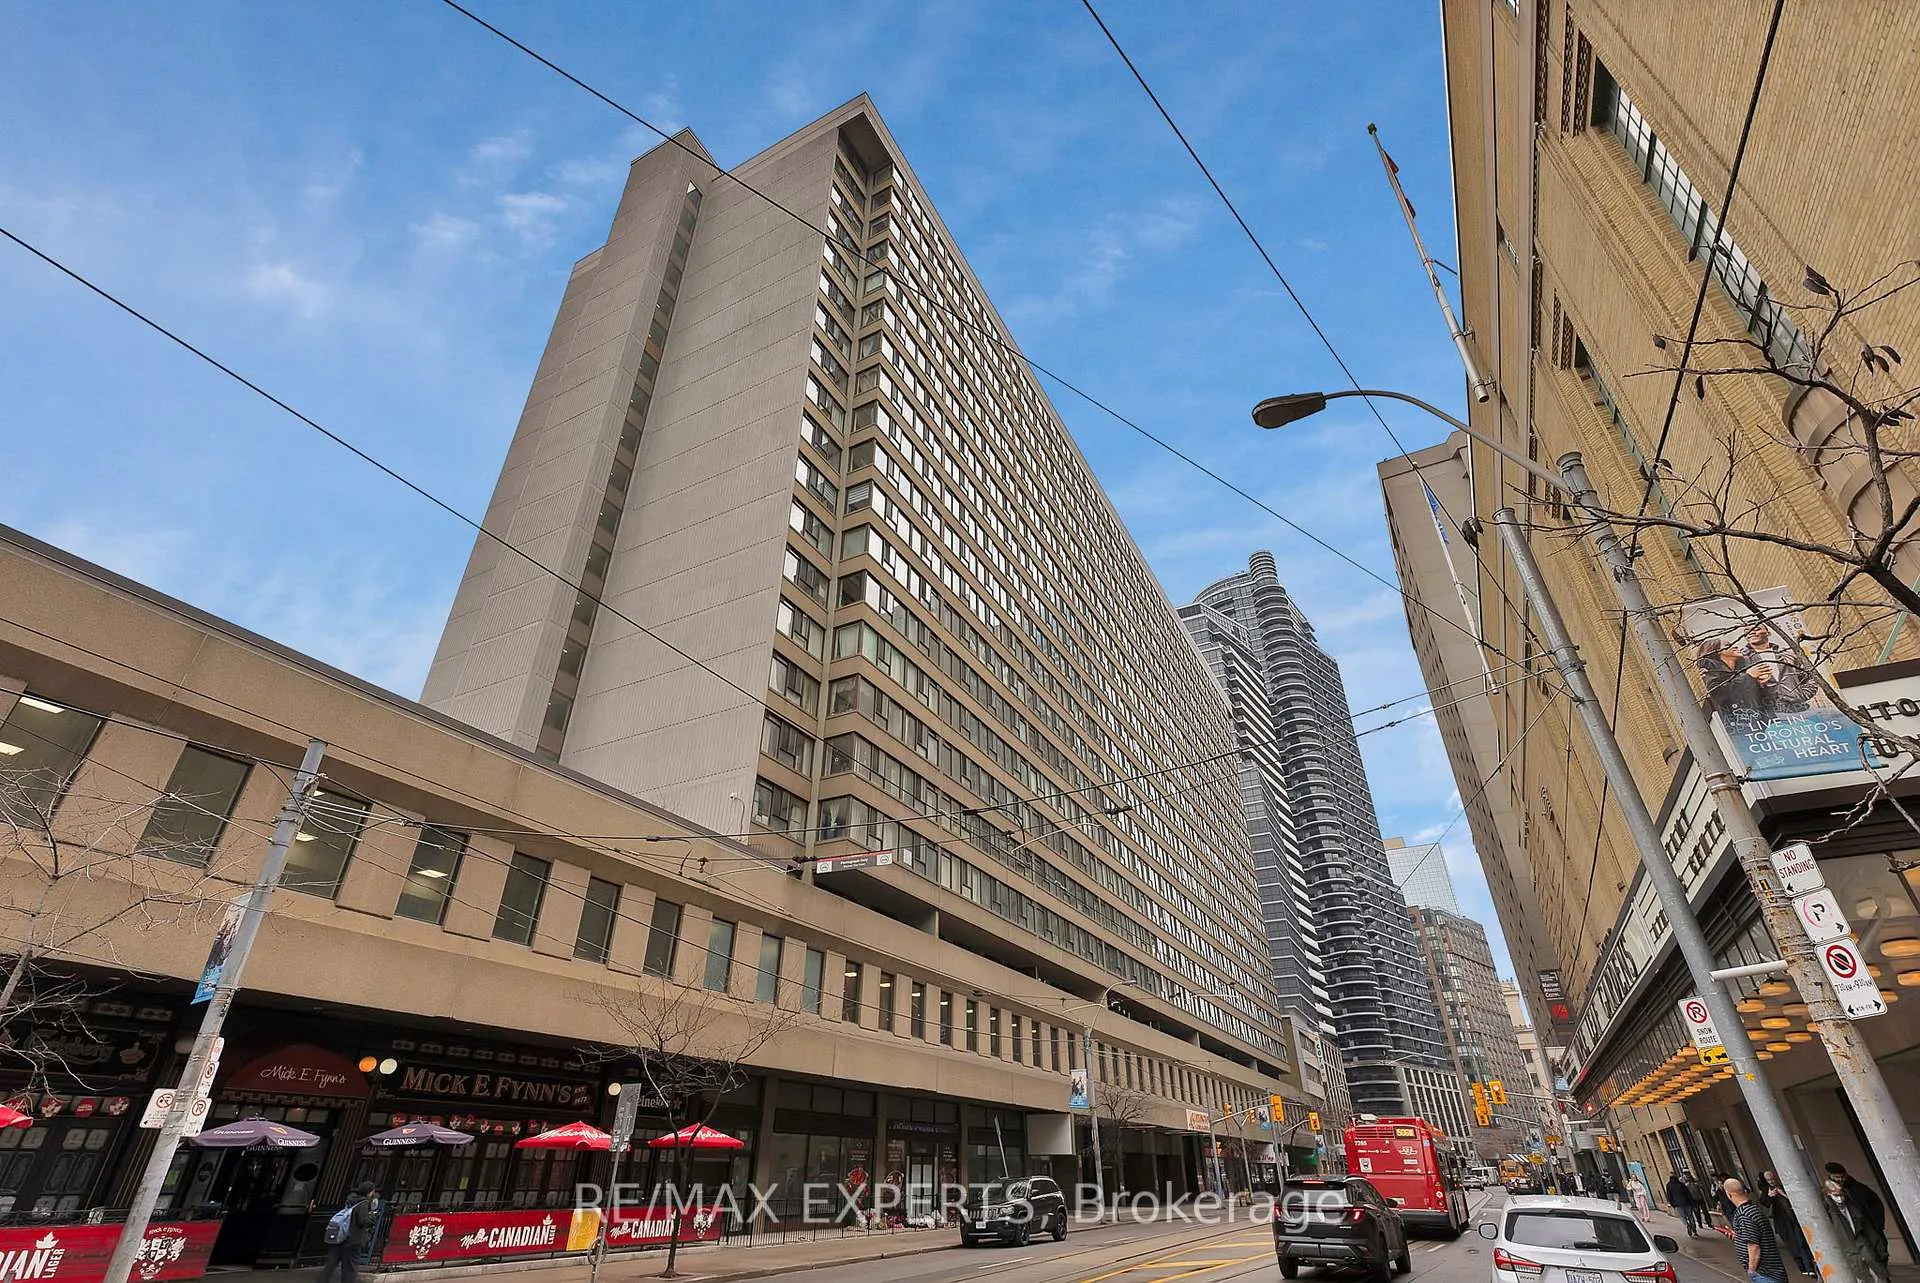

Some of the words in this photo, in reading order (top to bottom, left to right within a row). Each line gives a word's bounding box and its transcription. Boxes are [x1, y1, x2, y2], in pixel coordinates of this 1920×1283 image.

[1744, 720, 1842, 743] TORONTO'S
[1748, 717, 1783, 732] LIVE
[1786, 714, 1806, 726] IN
[1748, 733, 1835, 754] CULTURAL
[1794, 742, 1850, 759] HEART
[1783, 849, 1797, 862] NO
[1778, 859, 1815, 879] STANDING
[260, 1064, 297, 1081] Mick
[299, 1068, 312, 1081] E
[314, 1069, 348, 1089] Fynn's
[402, 1066, 472, 1096] MICK
[472, 1073, 491, 1097] E
[493, 1076, 572, 1104] FYNN'S
[277, 1138, 307, 1146] GUINNESS
[383, 1136, 417, 1146] GUINNESS
[460, 1228, 489, 1250] Molson
[488, 1225, 550, 1249] CANADIAN
[0, 1249, 50, 1280] IAN
[43, 1248, 65, 1279] LAGER
